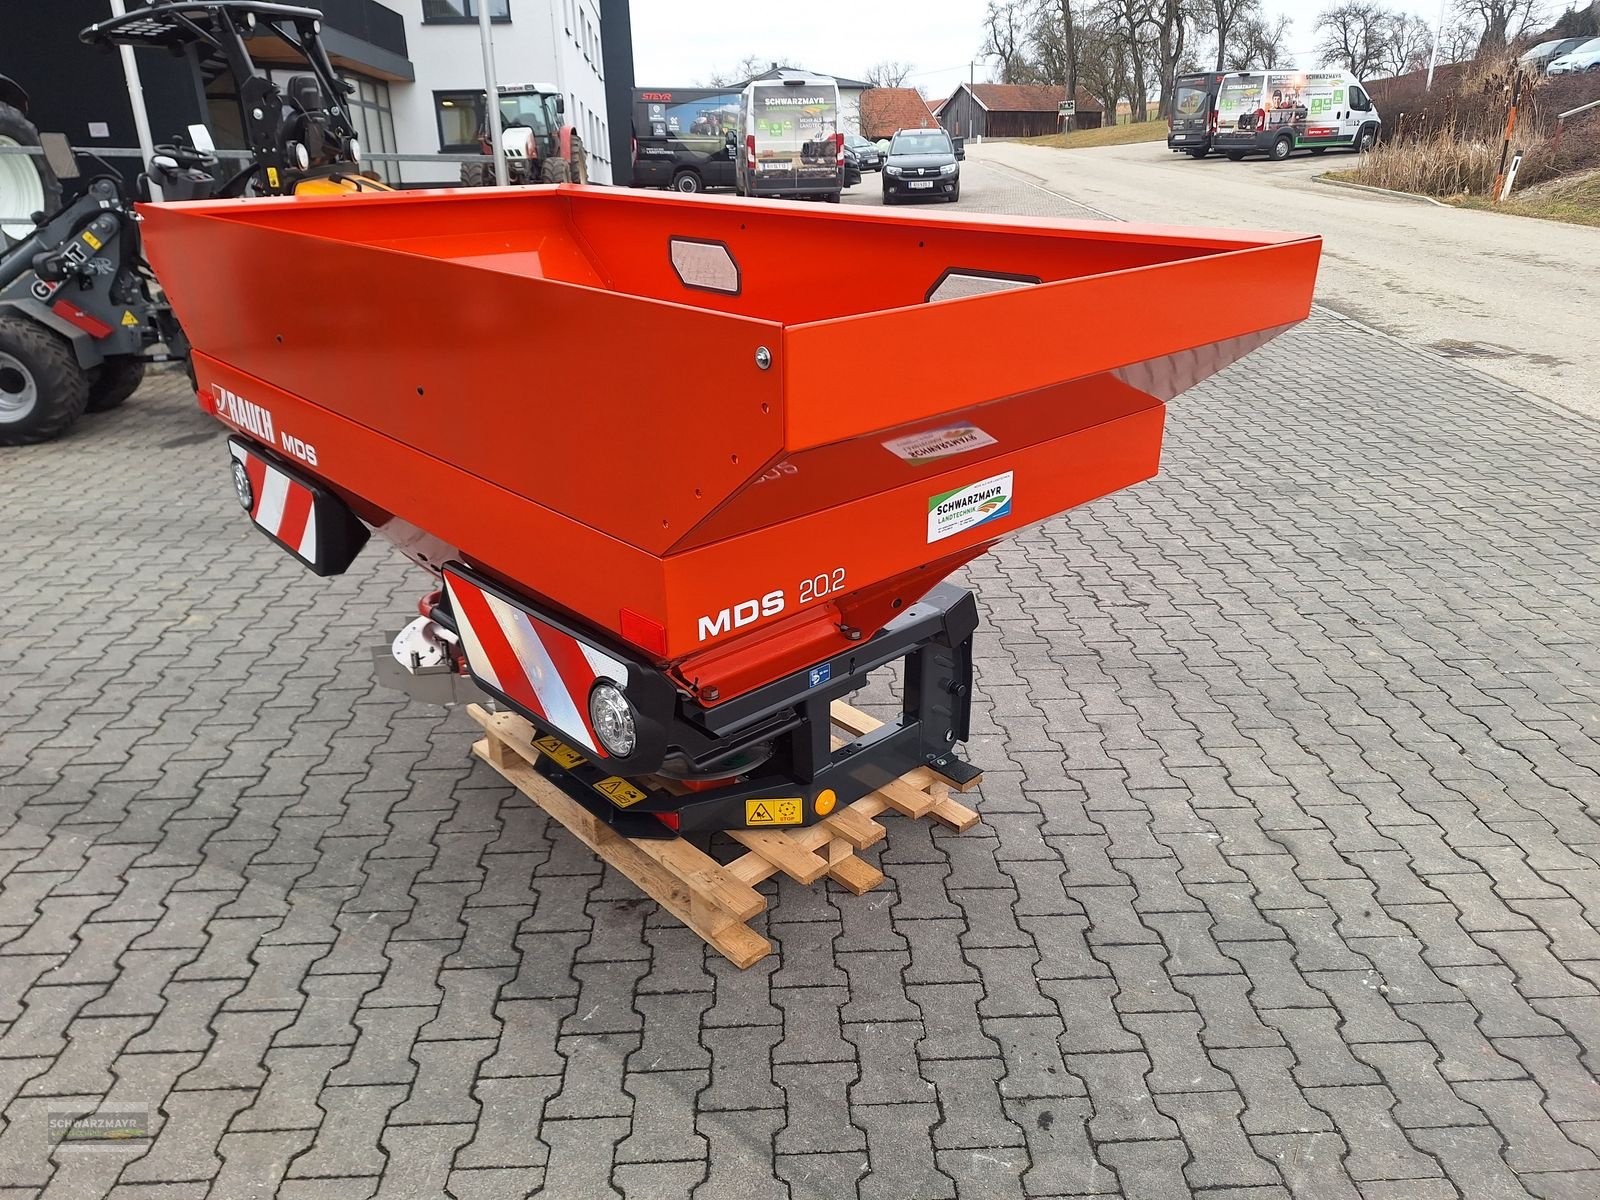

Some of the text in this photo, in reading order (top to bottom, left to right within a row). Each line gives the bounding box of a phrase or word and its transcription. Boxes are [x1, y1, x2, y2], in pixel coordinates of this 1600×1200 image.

[641, 92, 672, 100] STEYR
[765, 97, 825, 106] SCHWARZMAYR
[226, 390, 276, 444] RAUCH
[280, 431, 318, 466] MDS
[937, 486, 1002, 516] SCHWARZMAYR
[937, 506, 976, 524] LANDTECHNIK
[697, 567, 845, 641] MDS 20.2
